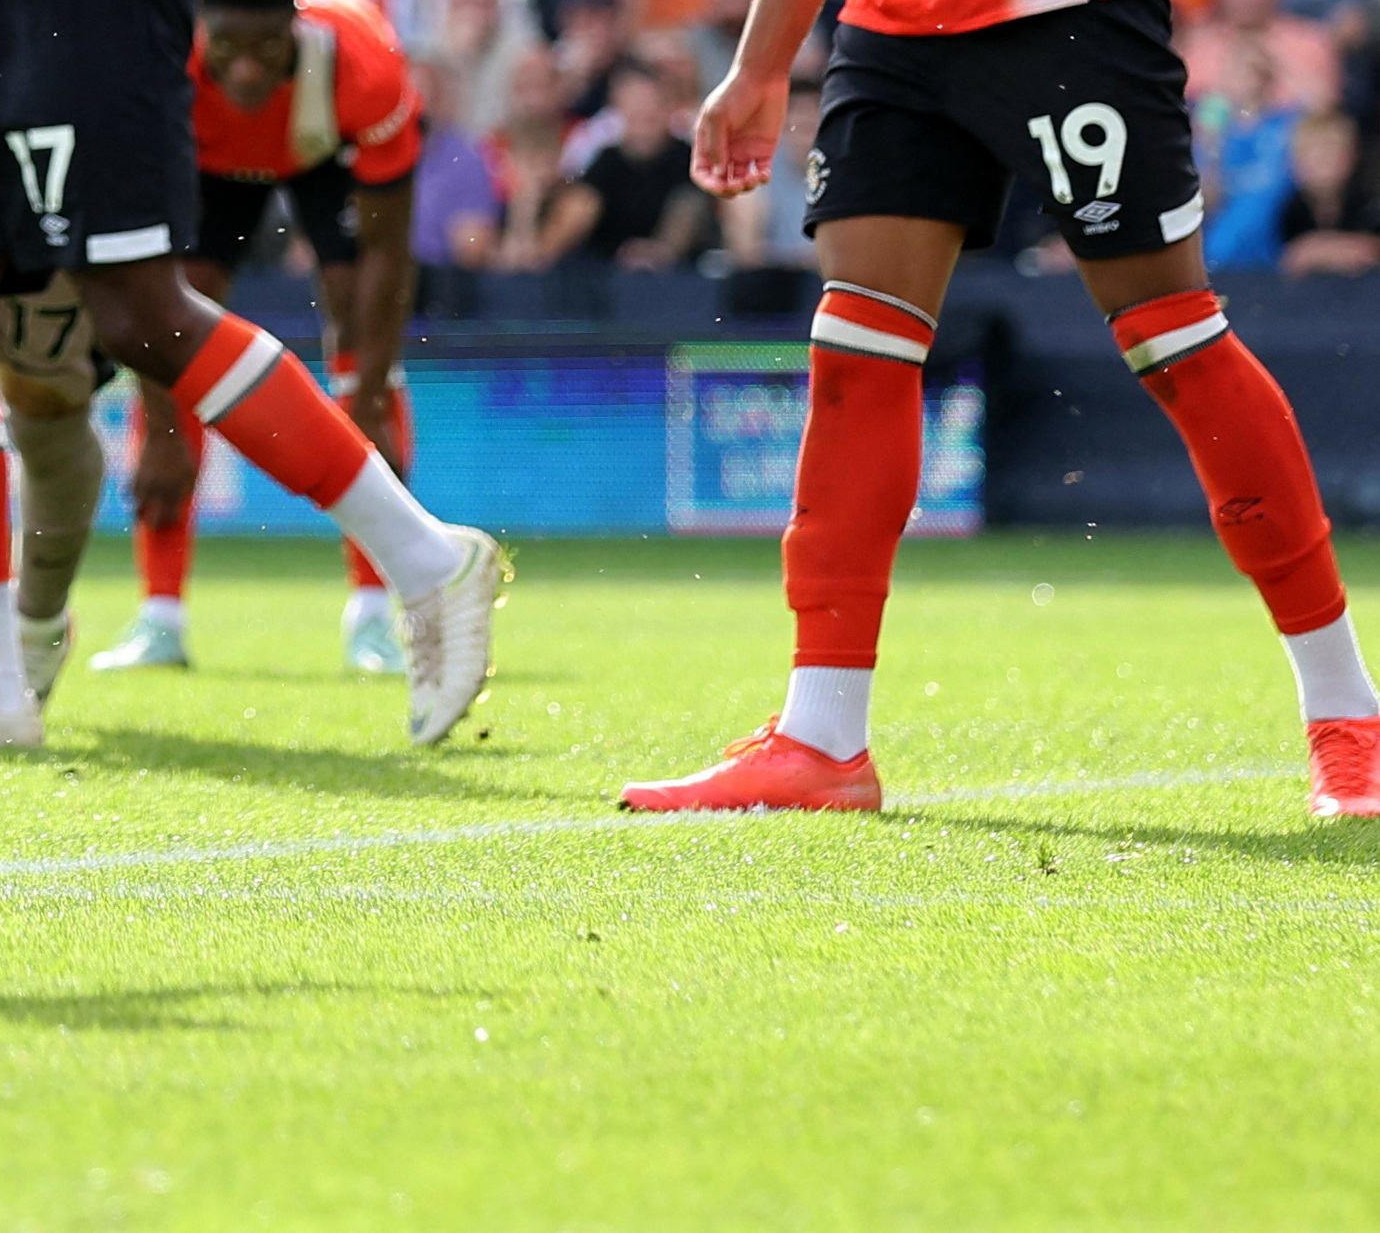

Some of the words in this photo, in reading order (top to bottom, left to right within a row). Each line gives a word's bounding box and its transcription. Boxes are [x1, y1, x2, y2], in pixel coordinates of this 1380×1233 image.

[4, 123, 77, 214] 17
[1027, 101, 1128, 205] 19
[11, 300, 80, 361] 17
